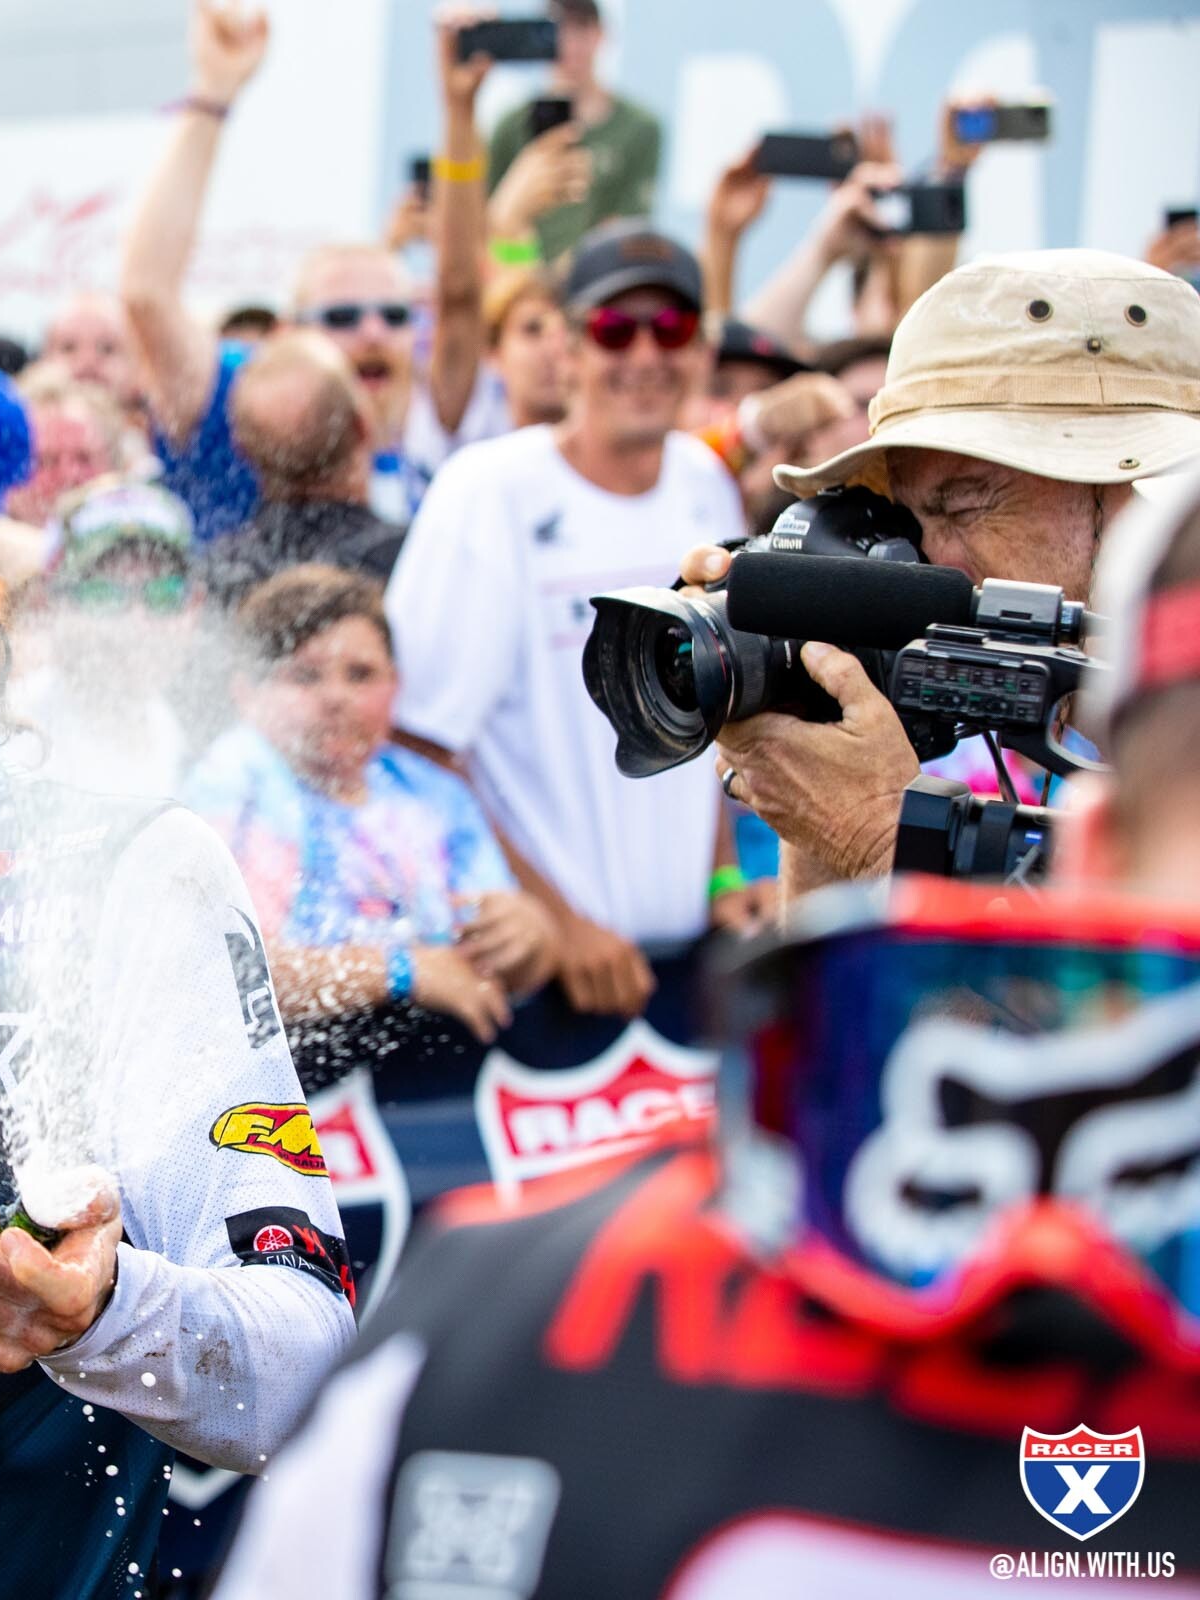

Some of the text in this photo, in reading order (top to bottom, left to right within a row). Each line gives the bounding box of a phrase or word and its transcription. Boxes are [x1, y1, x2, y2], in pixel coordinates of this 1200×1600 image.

[773, 536, 803, 551] Canon
[217, 1112, 324, 1158] FM
[508, 1083, 717, 1150] RACE
